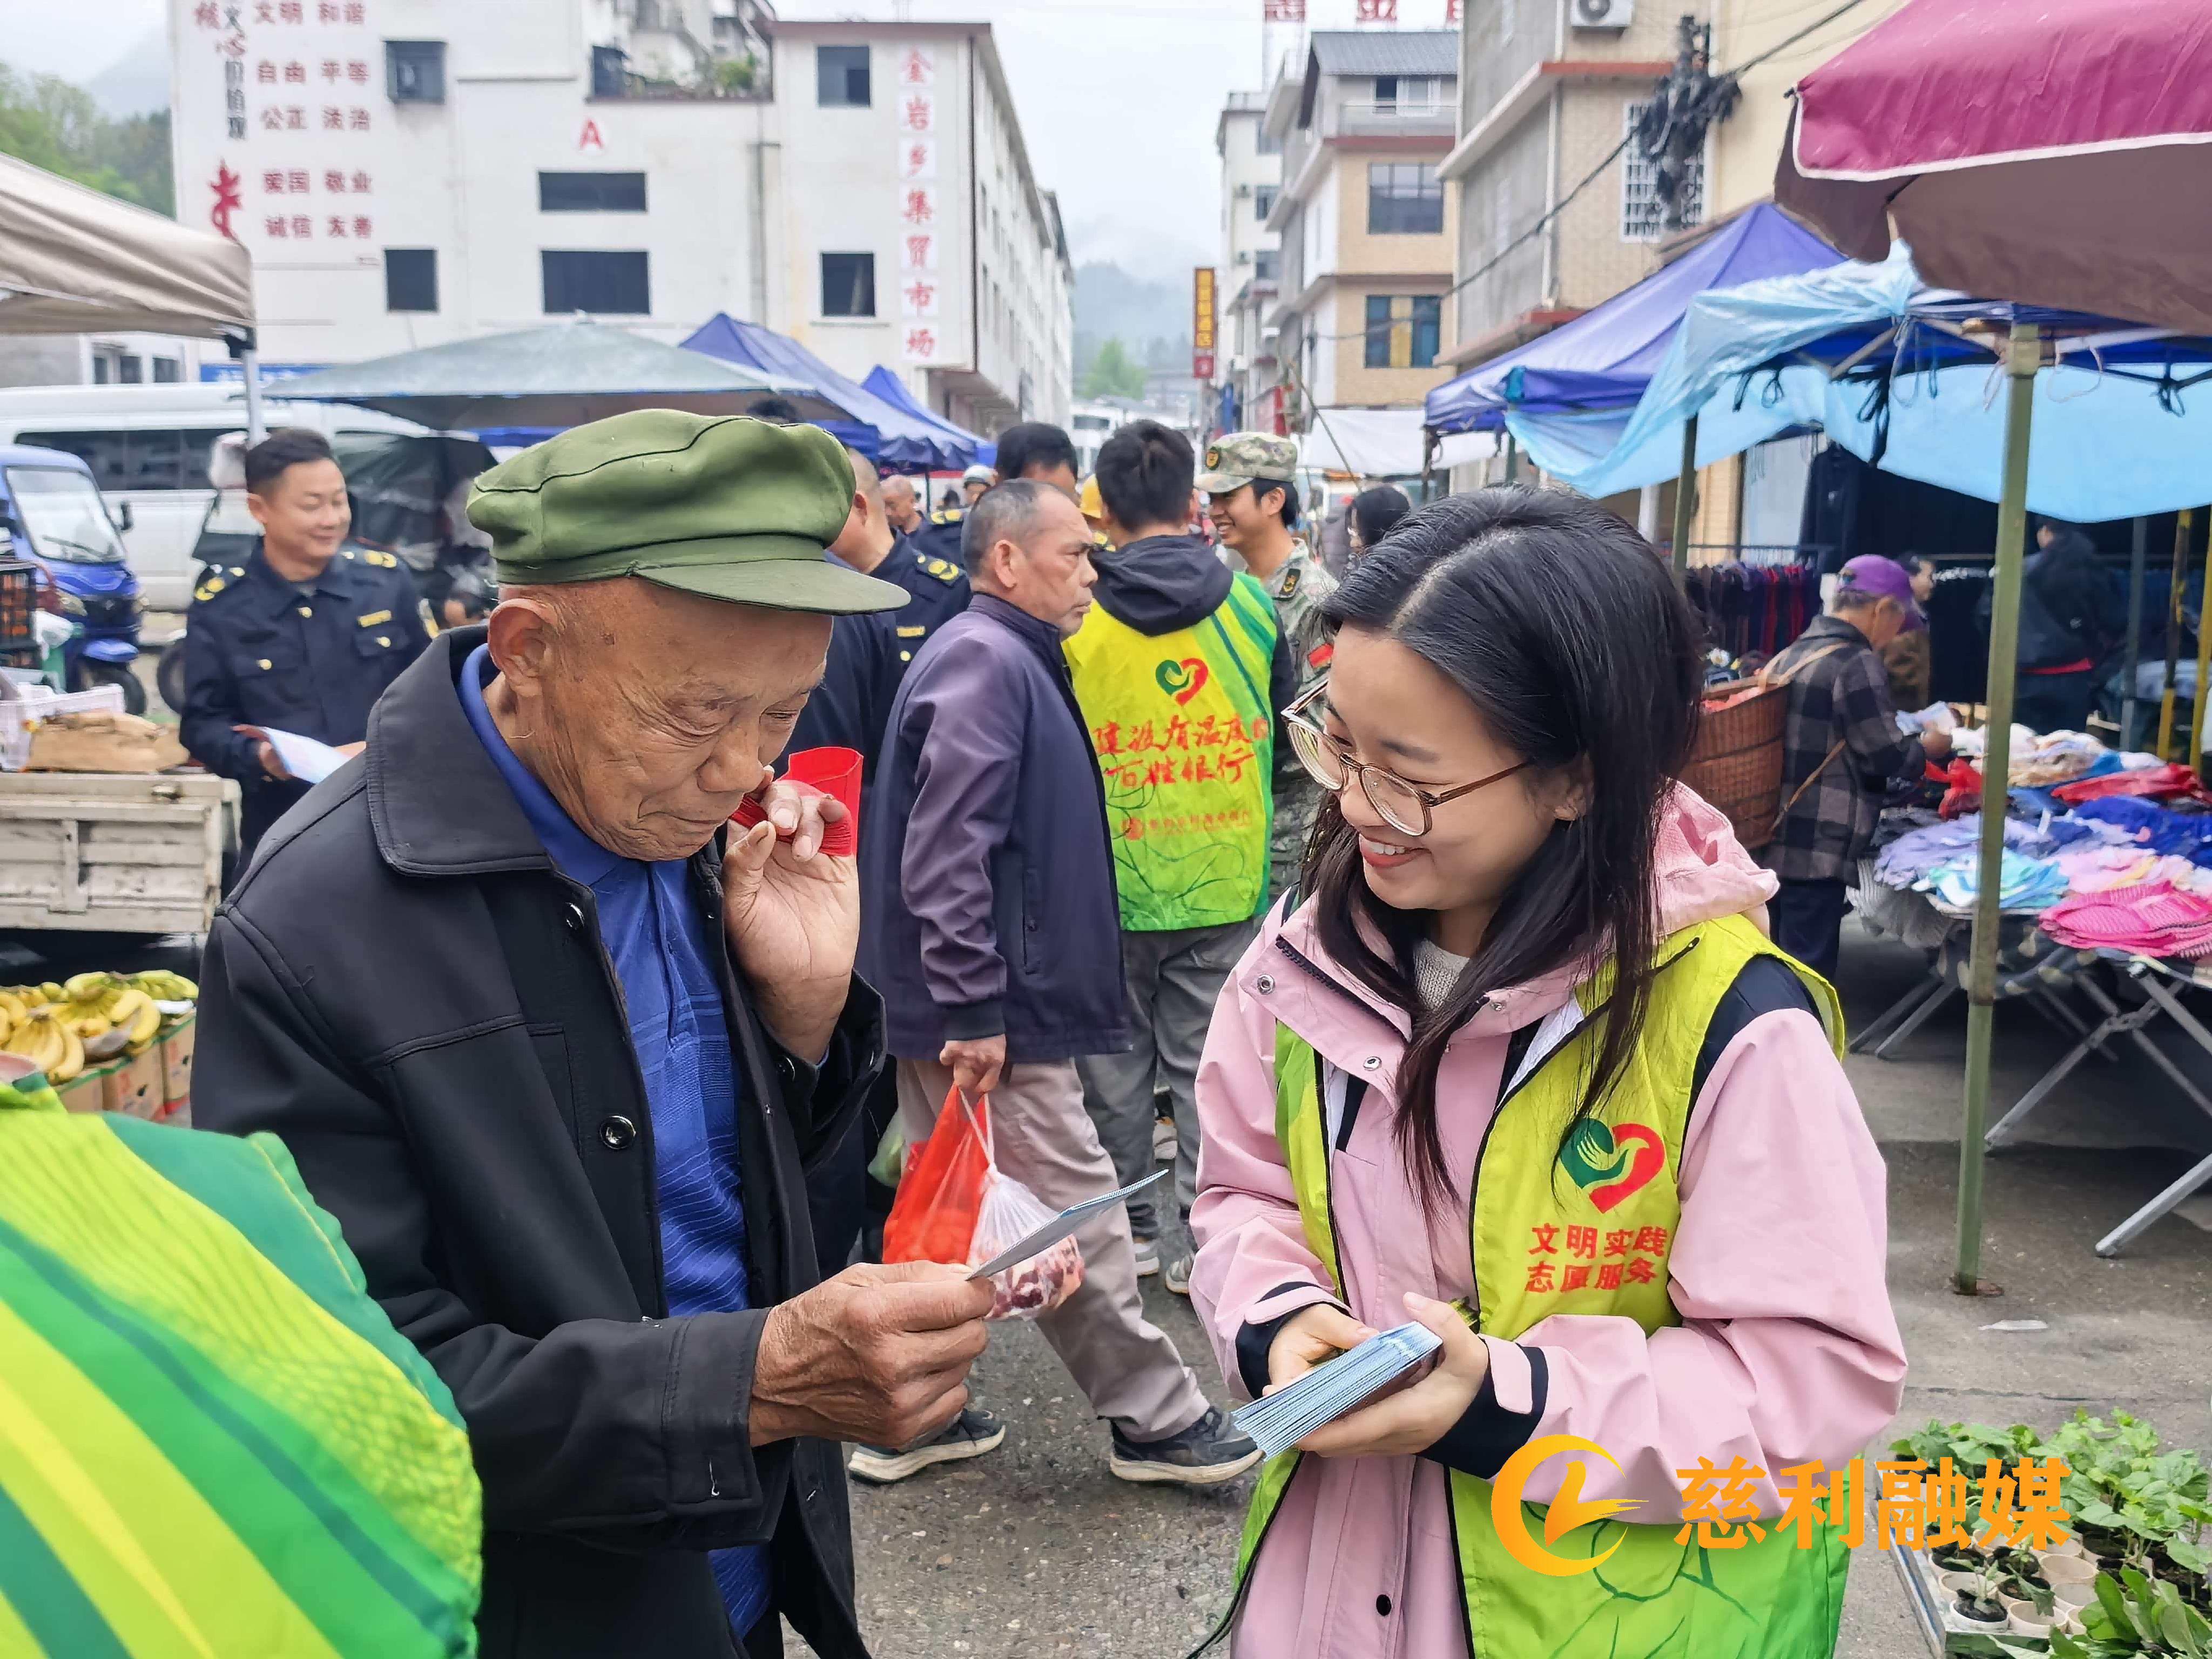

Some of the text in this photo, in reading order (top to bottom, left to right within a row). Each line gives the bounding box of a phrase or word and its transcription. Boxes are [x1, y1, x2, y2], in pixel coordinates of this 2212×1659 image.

[257, 59, 307, 83] 自由
[1105, 747, 1254, 787] 百姓银行
[1528, 1223, 1669, 1259] 文明实践
[1525, 1257, 1657, 1293] 志愿服务
